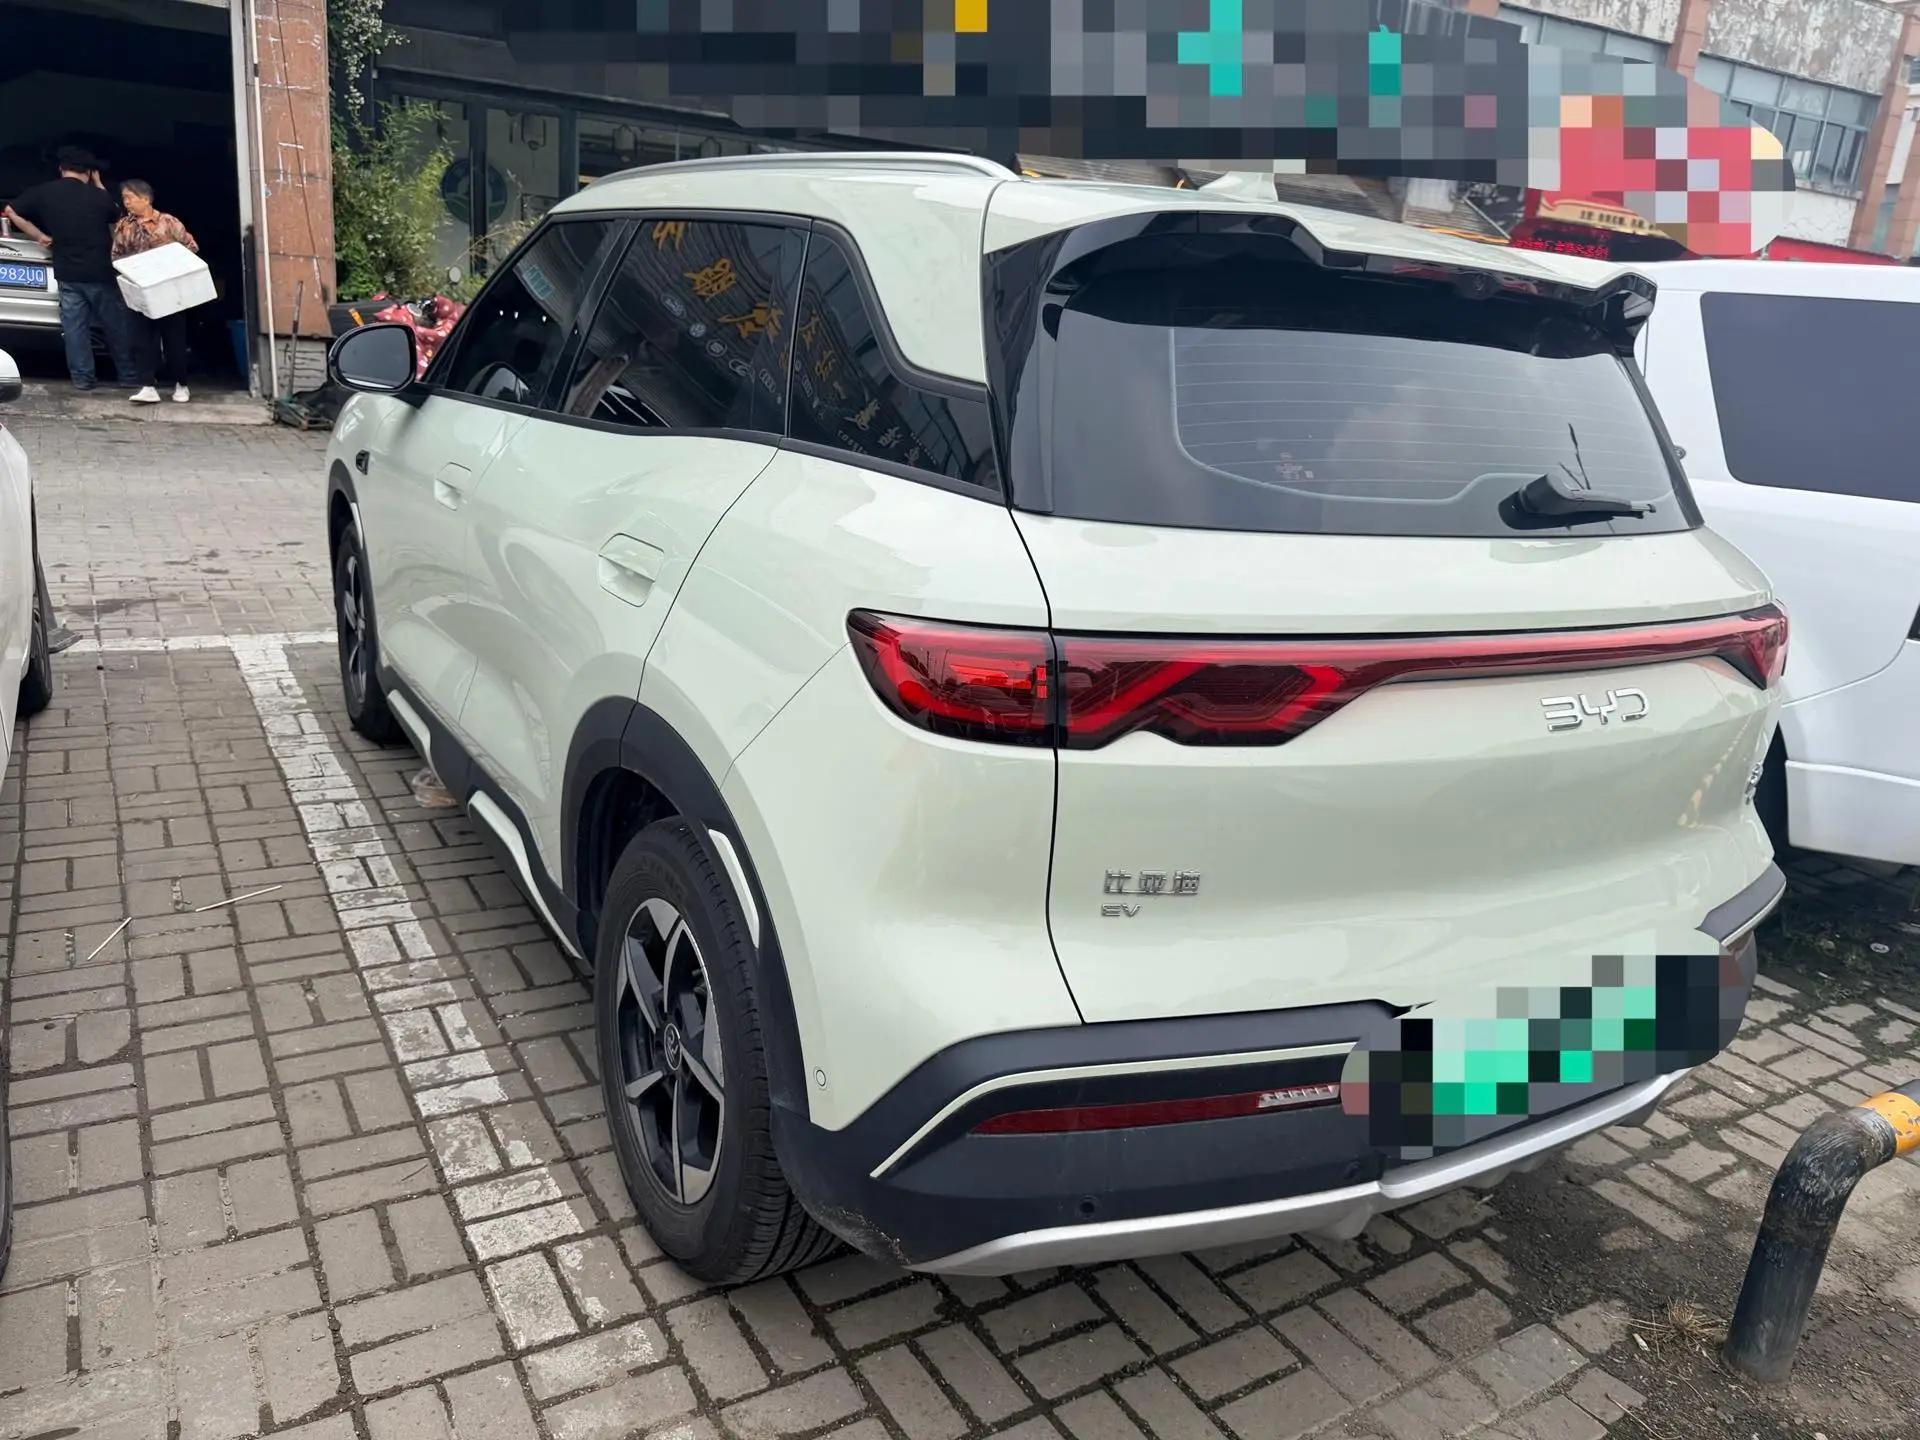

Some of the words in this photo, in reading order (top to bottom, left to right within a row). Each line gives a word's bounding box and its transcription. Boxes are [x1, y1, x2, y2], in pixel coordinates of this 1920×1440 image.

[0, 266, 44, 282] 982UQ
[1541, 687, 1650, 732] BYD
[1104, 869, 1201, 895] 比亚迪
[1101, 902, 1142, 917] EV
